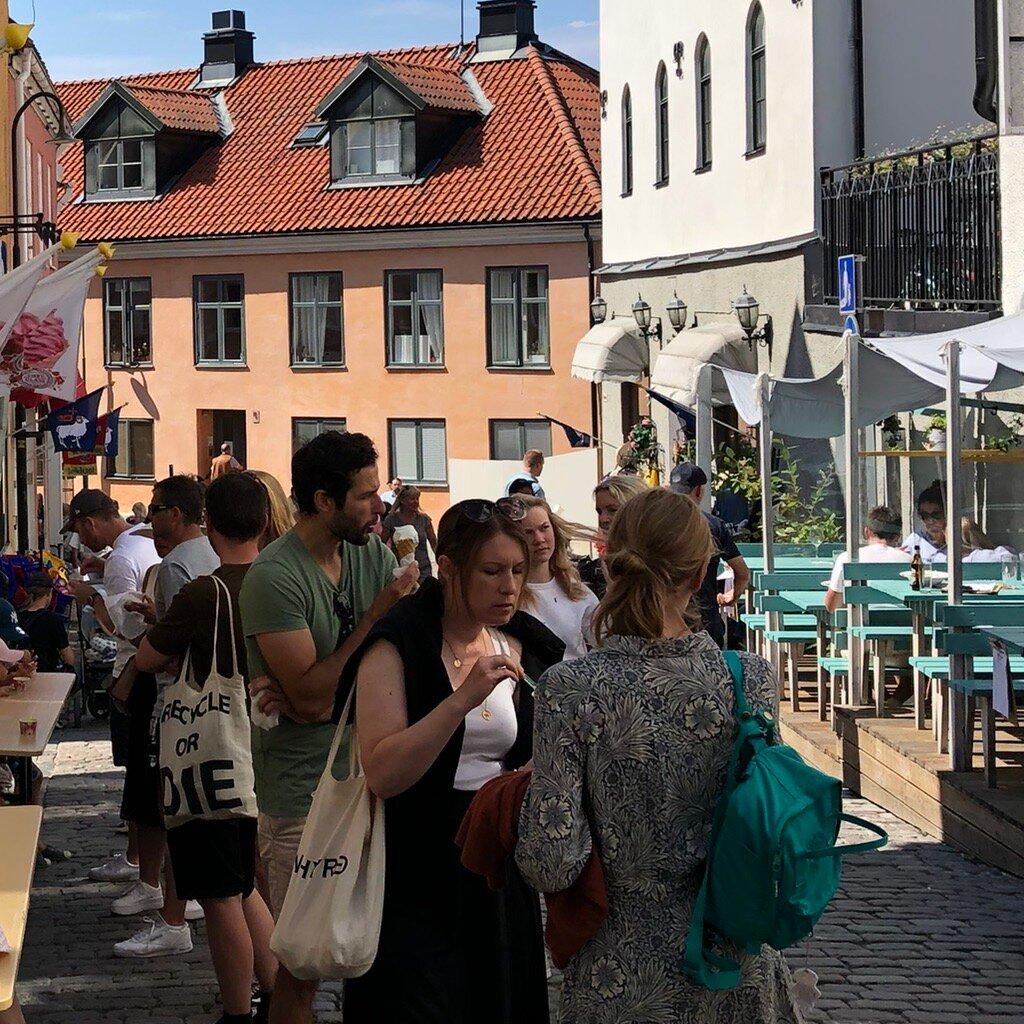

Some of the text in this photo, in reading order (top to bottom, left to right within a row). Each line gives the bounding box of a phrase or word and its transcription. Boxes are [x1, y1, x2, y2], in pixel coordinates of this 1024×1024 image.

[160, 691, 231, 725] RECYCLE
[176, 732, 200, 756] OR
[159, 760, 243, 816] DIE
